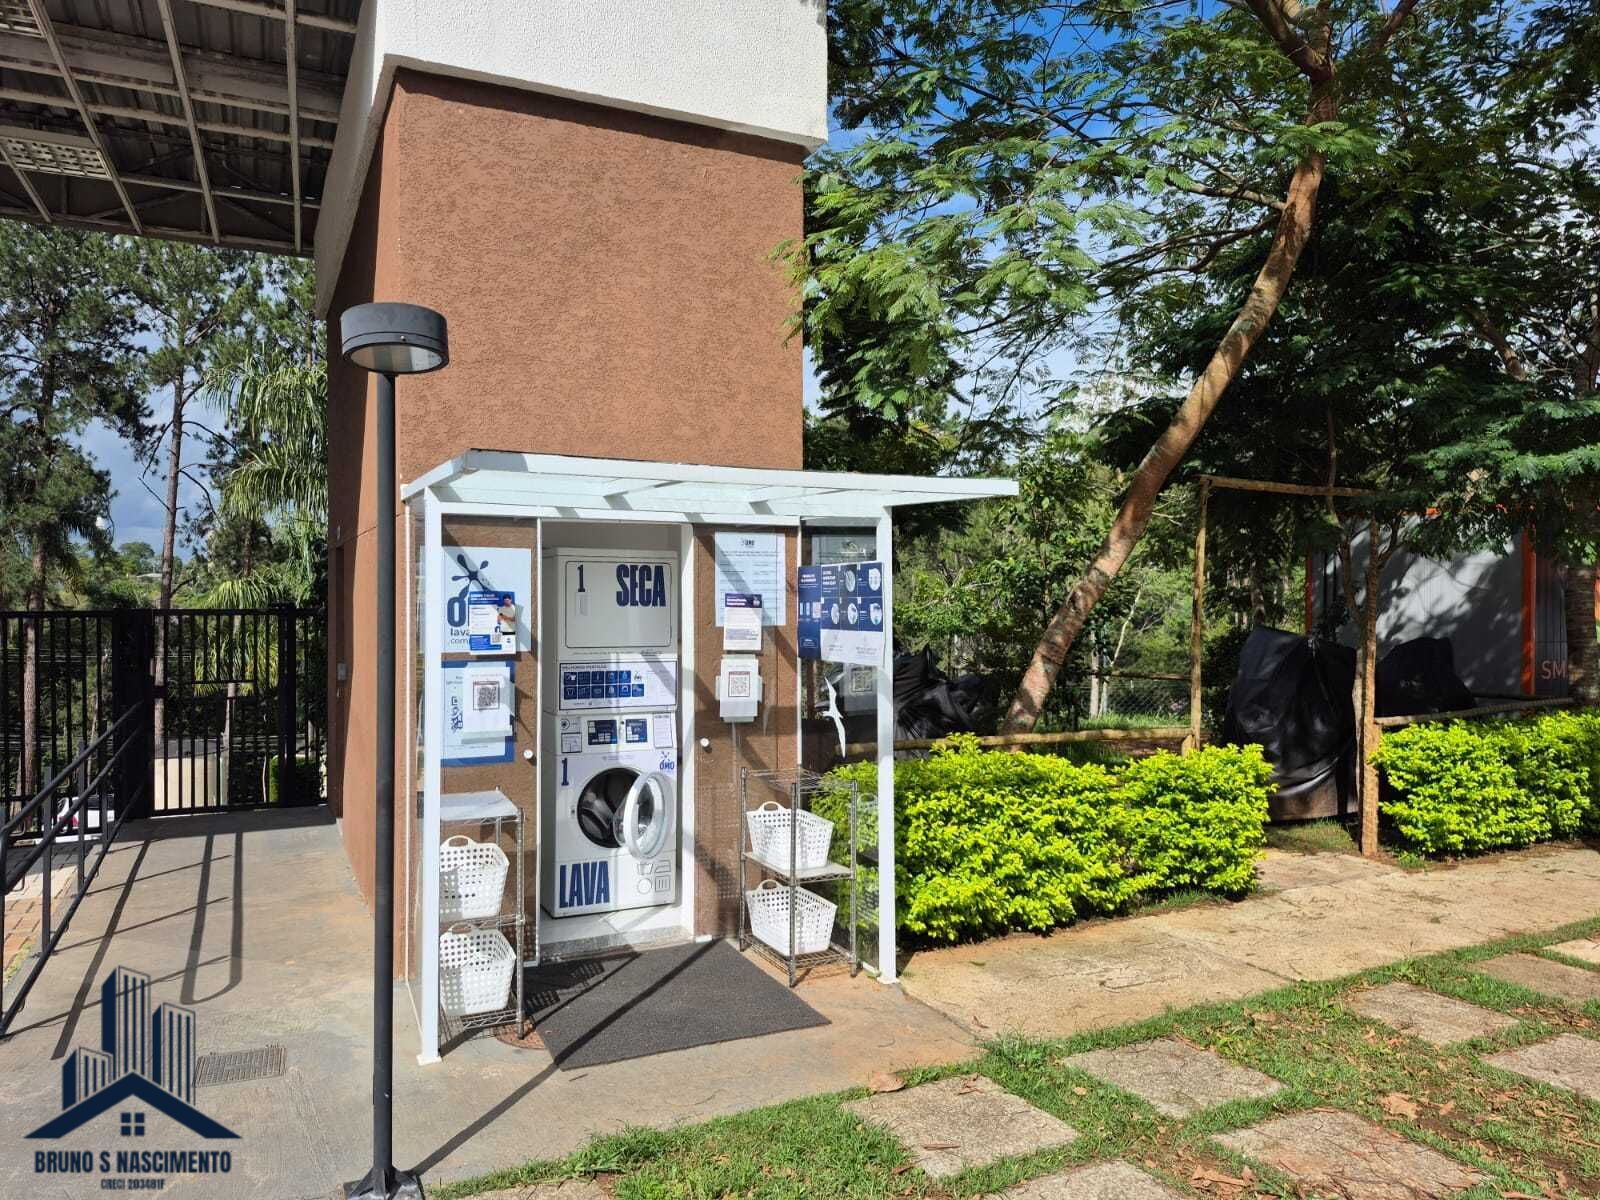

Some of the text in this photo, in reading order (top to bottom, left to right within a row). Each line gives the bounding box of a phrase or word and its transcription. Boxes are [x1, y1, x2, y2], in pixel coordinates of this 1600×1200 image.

[577, 564, 667, 607] 1 SECA
[560, 757, 570, 786] 1
[559, 860, 611, 909] LAVA
